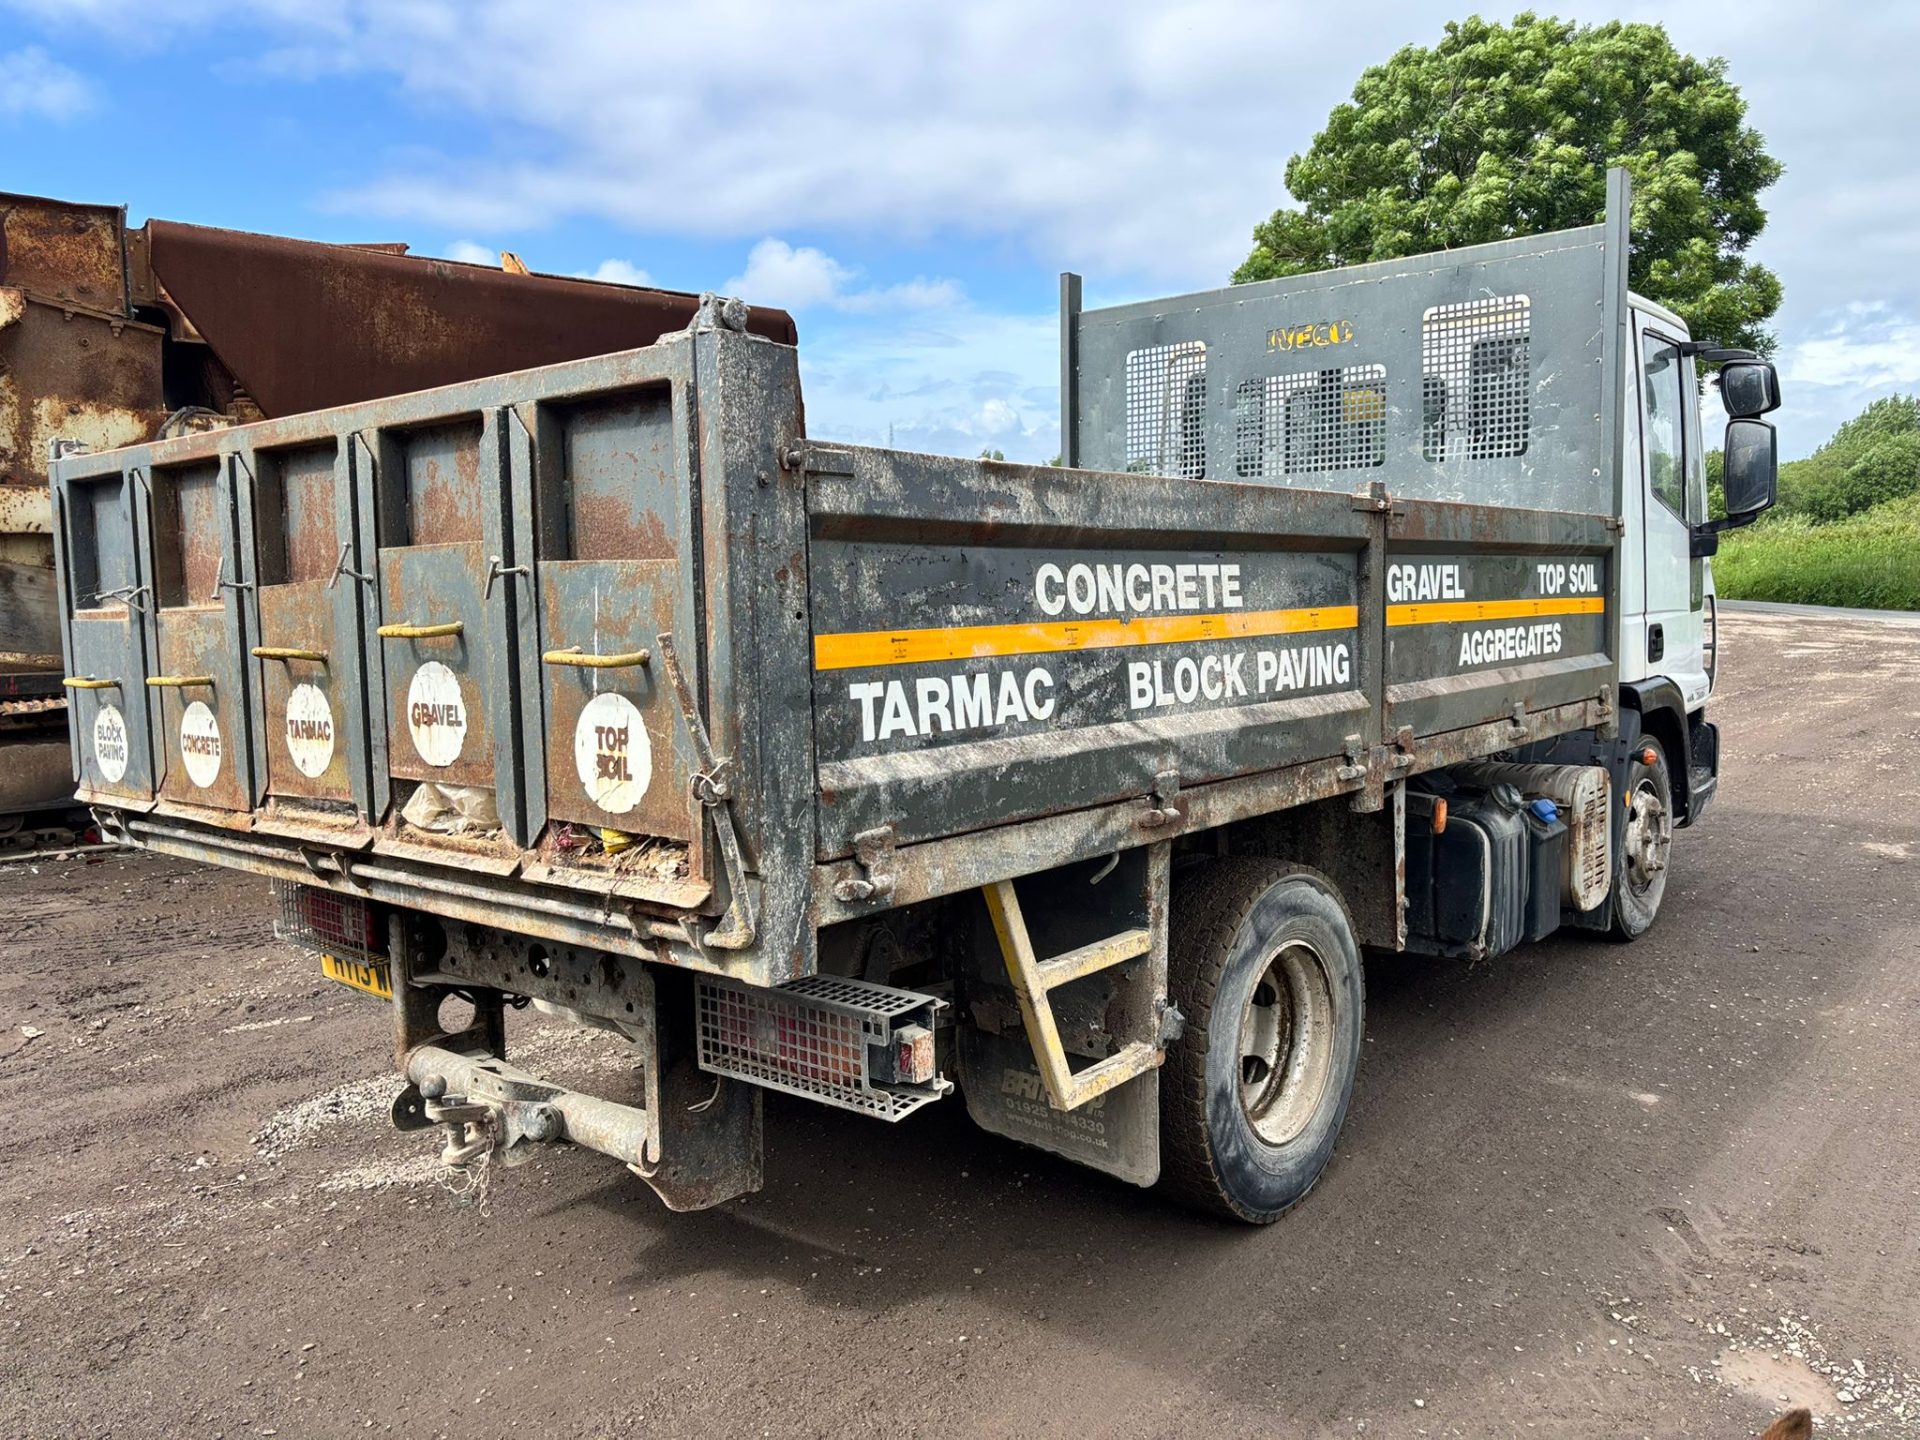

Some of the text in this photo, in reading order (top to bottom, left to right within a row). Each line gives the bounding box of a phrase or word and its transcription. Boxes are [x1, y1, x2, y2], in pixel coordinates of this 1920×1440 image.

[1266, 320, 1353, 353] IVECO
[1035, 562, 1244, 616] CONCRETE
[1386, 563, 1466, 603] GRAVEL
[1536, 562, 1598, 595] TOP SOIL
[1458, 622, 1563, 667] AGGREGATES
[1128, 643, 1350, 710] BLOCK PAVING
[411, 702, 463, 728] GRAVEL
[849, 667, 1056, 743] TARMAC
[97, 724, 123, 743] BLOCK
[182, 733, 220, 757] CONCRETE
[288, 719, 331, 742] TARMAC
[594, 725, 629, 752] TOP
[97, 742, 125, 762] PAVING
[596, 753, 633, 782] SOIL
[1006, 1098, 1049, 1118] 01925
